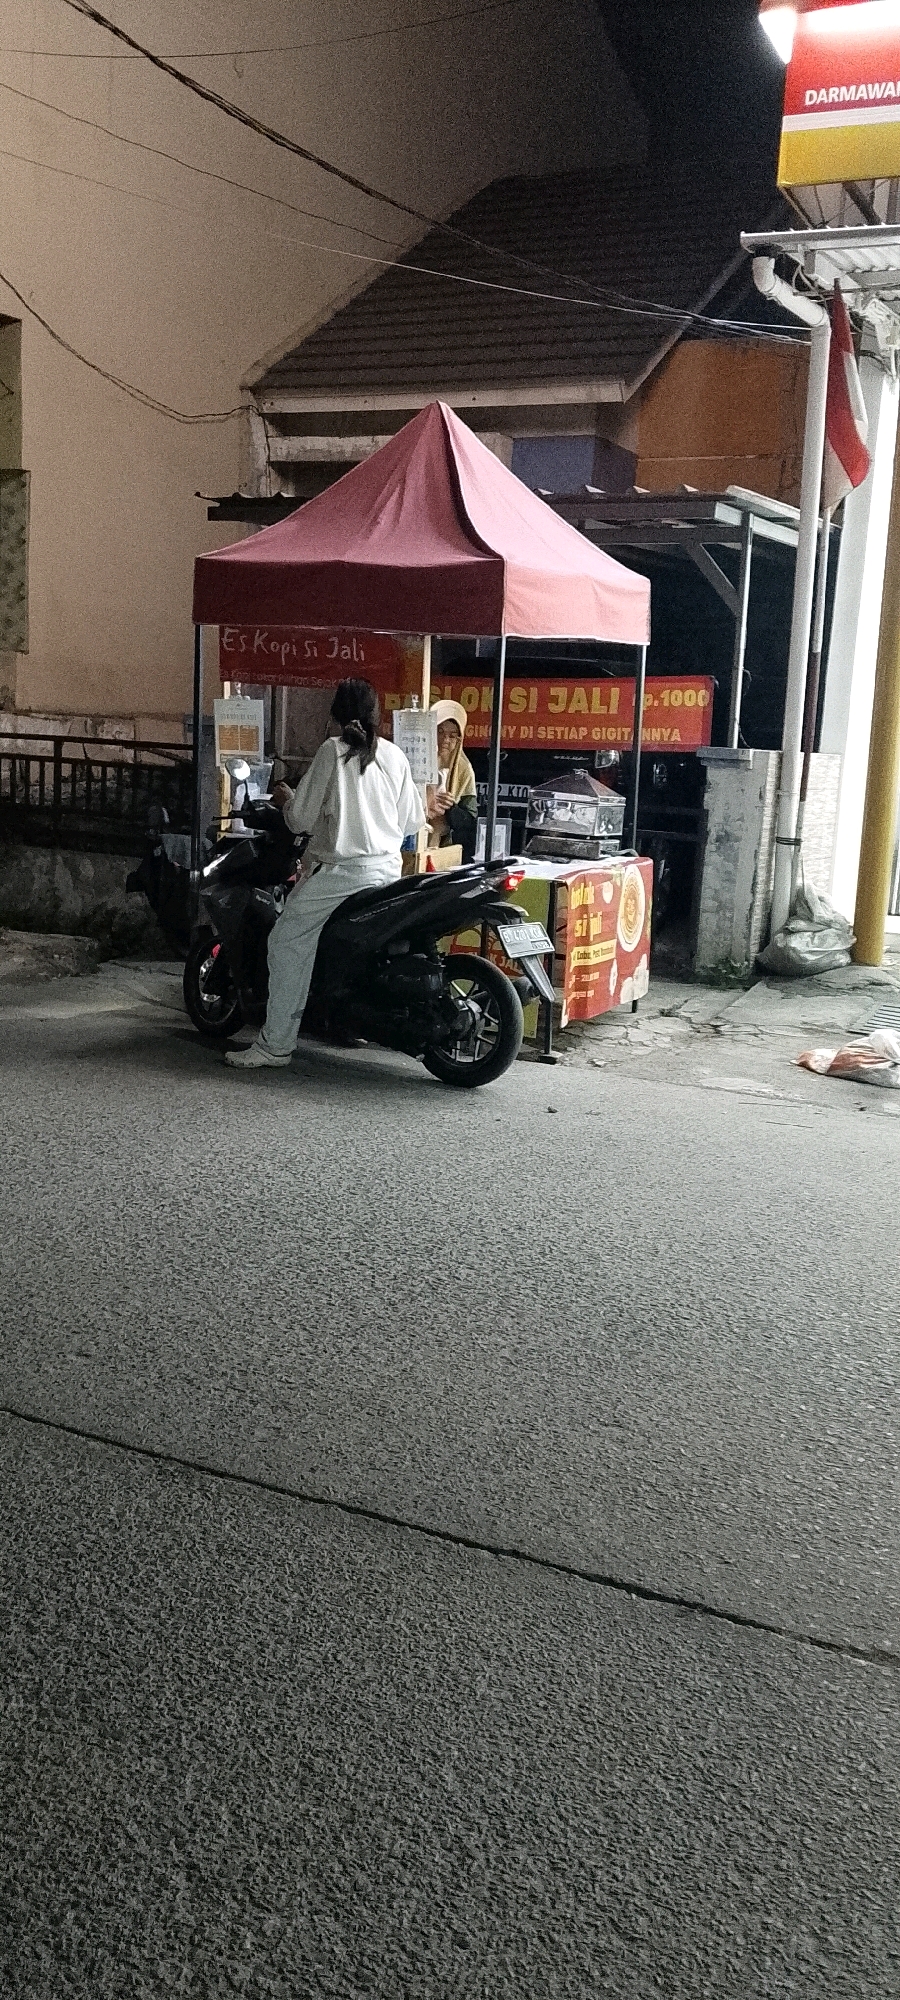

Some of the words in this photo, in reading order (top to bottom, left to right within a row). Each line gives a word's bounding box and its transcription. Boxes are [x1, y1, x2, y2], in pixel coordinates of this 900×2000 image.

[804, 81, 900, 106] DARMAWA
[221, 627, 247, 653] Es
[253, 628, 296, 666] Kopi
[326, 636, 365, 661] Jali
[507, 686, 538, 713] SI
[548, 686, 620, 715] JALI
[632, 688, 710, 711] p.1000
[520, 725, 534, 739] DI
[537, 726, 588, 741] SETIAP
[574, 913, 588, 938] si
